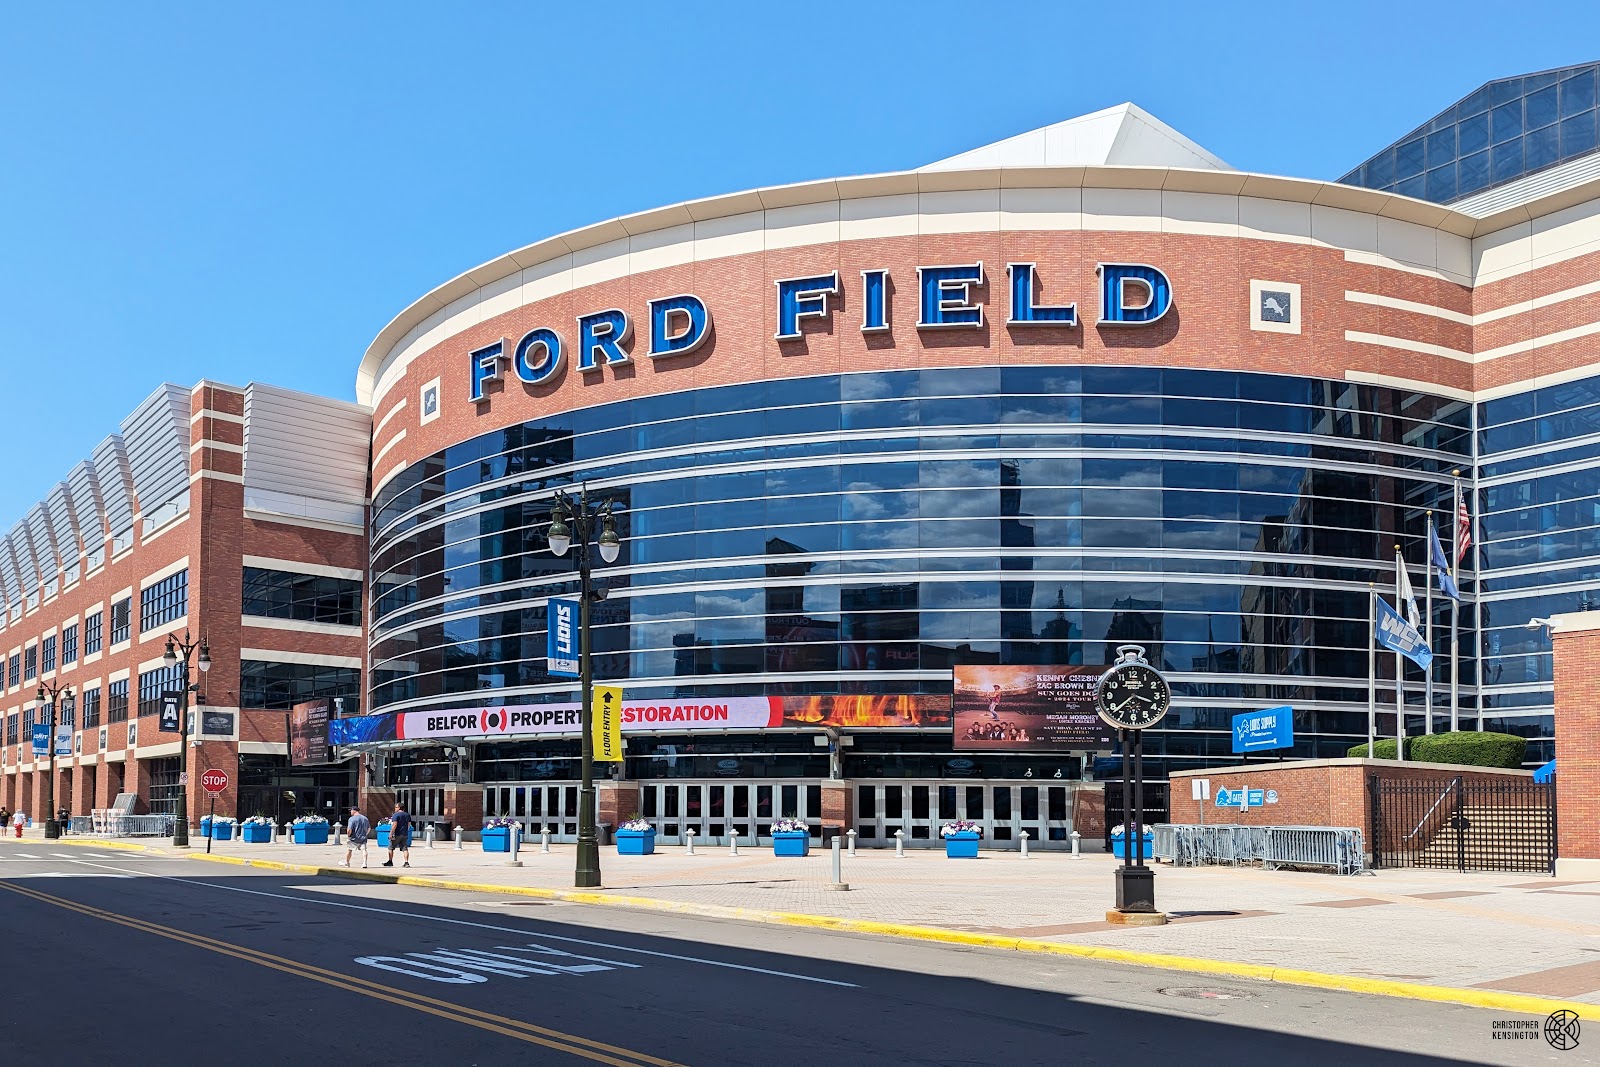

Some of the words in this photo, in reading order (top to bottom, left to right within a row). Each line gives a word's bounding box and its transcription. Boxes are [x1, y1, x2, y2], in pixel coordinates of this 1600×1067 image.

[468, 294, 714, 403] FORD
[774, 260, 1174, 341] FIELD
[557, 604, 571, 654] LIONS
[163, 704, 178, 720] A
[428, 714, 477, 731] BELFOR
[511, 710, 582, 726] PROPERT
[621, 705, 728, 722] STORATION
[1250, 718, 1260, 731] LIONS
[203, 776, 226, 785] STOP
